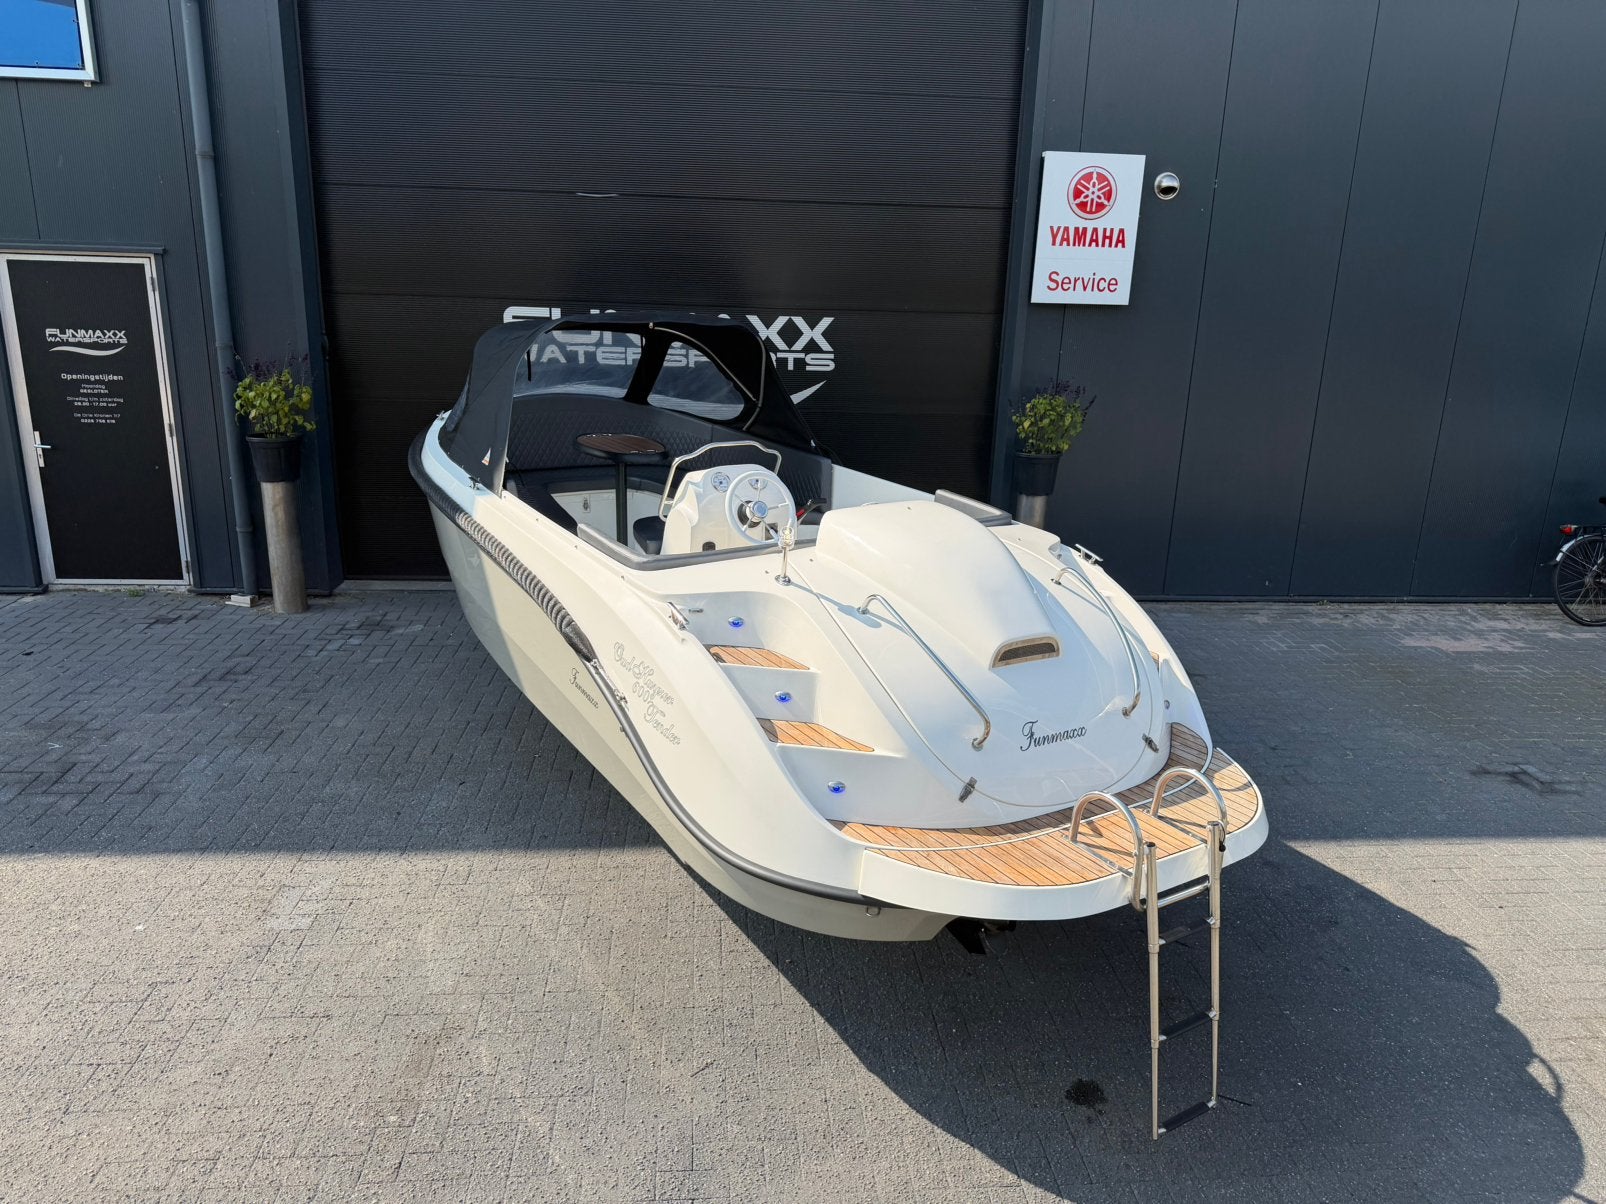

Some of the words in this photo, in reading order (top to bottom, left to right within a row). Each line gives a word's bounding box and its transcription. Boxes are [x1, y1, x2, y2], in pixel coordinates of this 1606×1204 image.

[1049, 225, 1126, 249] YAMAHA
[1046, 270, 1119, 293] Service
[45, 328, 126, 339] FUNMAXX
[61, 373, 124, 381] Openingstijden
[1020, 719, 1087, 752] Funmaxx
